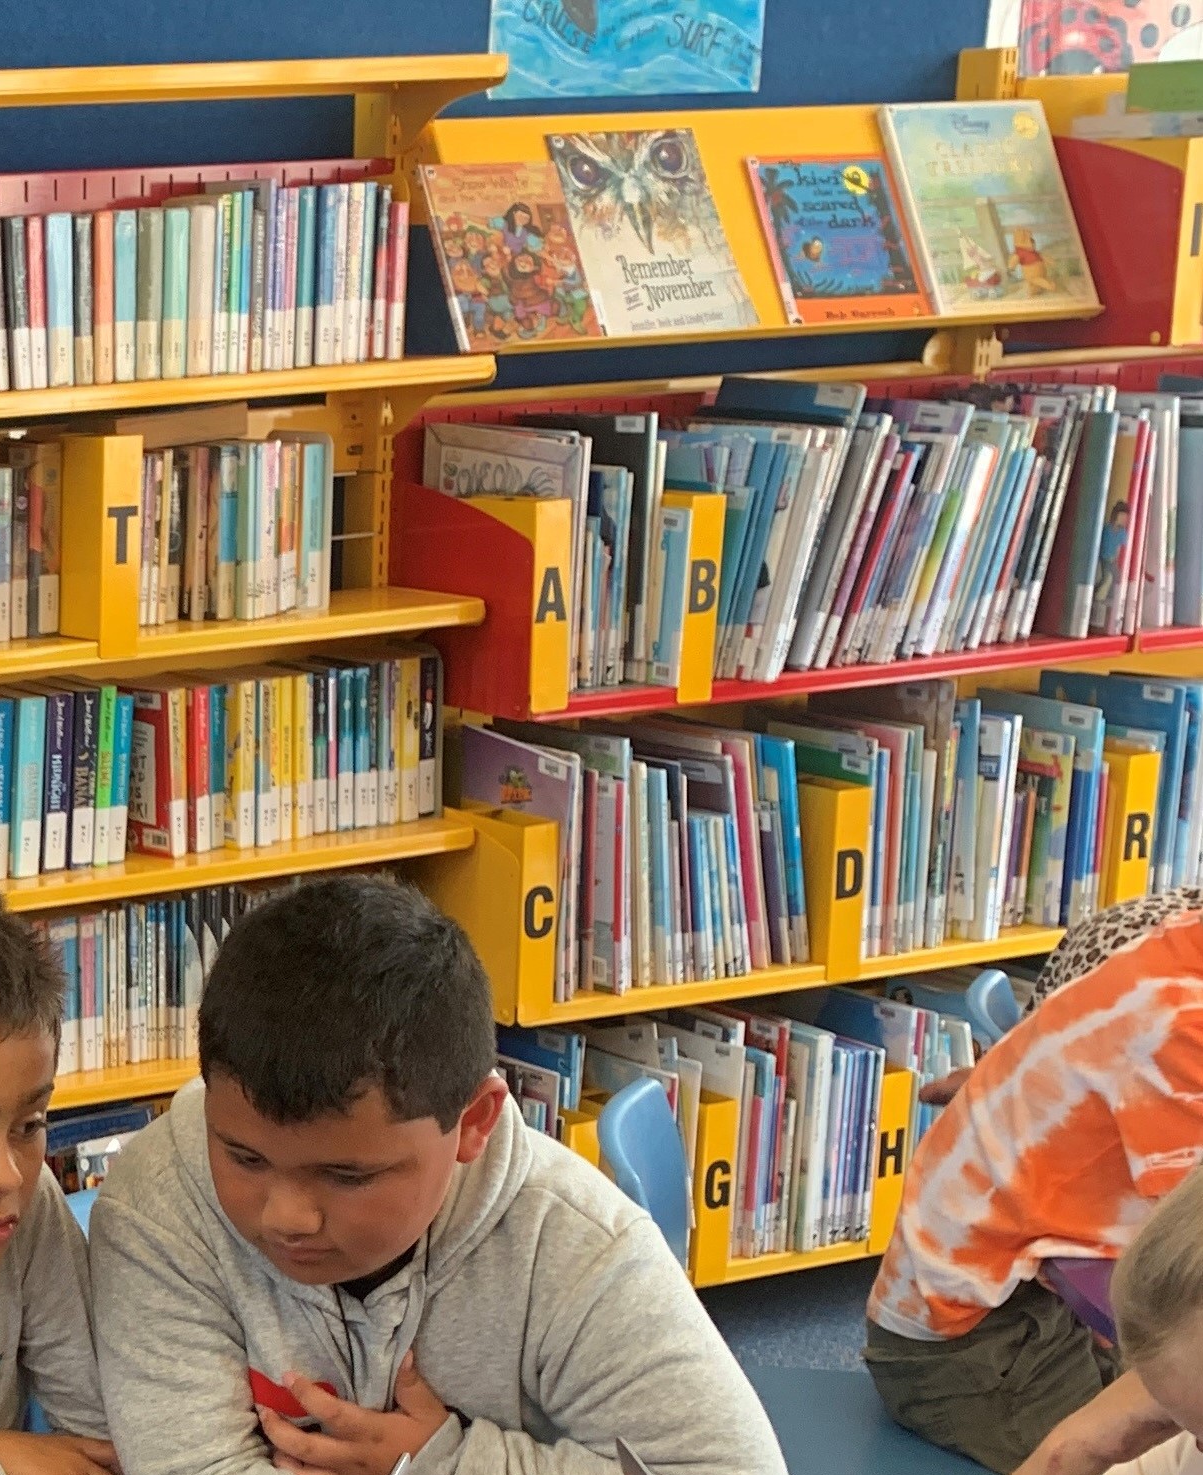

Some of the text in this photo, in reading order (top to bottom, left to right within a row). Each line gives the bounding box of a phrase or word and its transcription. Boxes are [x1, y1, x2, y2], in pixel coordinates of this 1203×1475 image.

[615, 252, 694, 285] Remember
[641, 276, 717, 311] November
[107, 505, 139, 565] T
[534, 567, 567, 624] A
[688, 559, 717, 614] B
[1123, 812, 1151, 862] R
[835, 849, 863, 900] D
[523, 886, 554, 939] C
[878, 1128, 905, 1178] H
[704, 1159, 730, 1209] G
